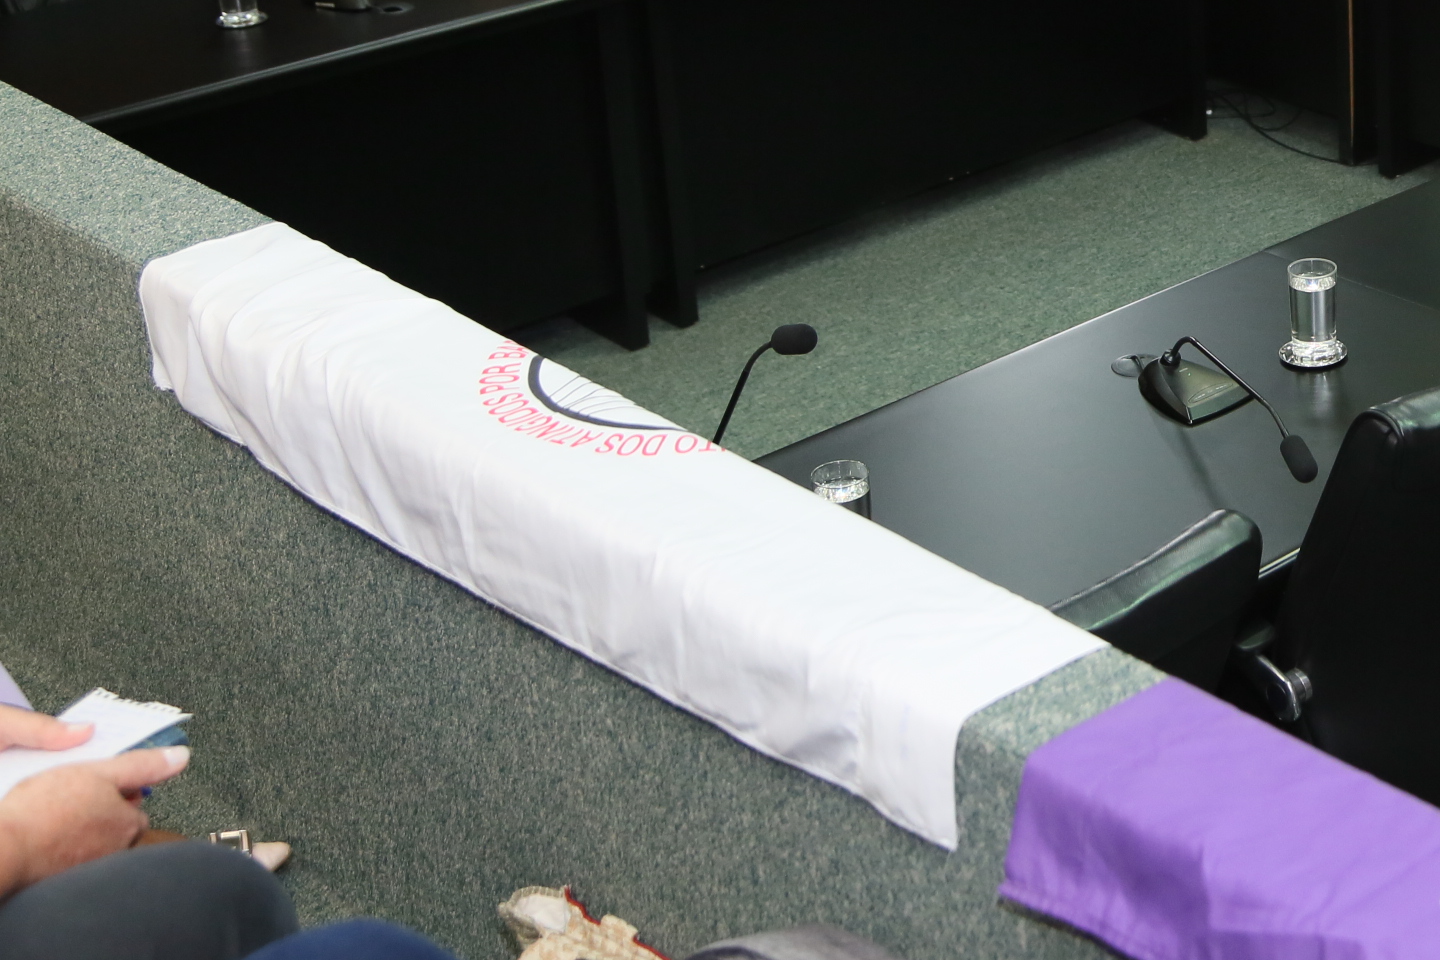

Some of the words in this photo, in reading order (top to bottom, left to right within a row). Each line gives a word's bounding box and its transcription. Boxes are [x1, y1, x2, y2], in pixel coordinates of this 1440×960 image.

[488, 340, 530, 360] BA
[478, 362, 522, 395] POR
[482, 392, 604, 448] ATINGIDOS
[595, 433, 667, 456] DOS
[674, 434, 726, 453] TO
